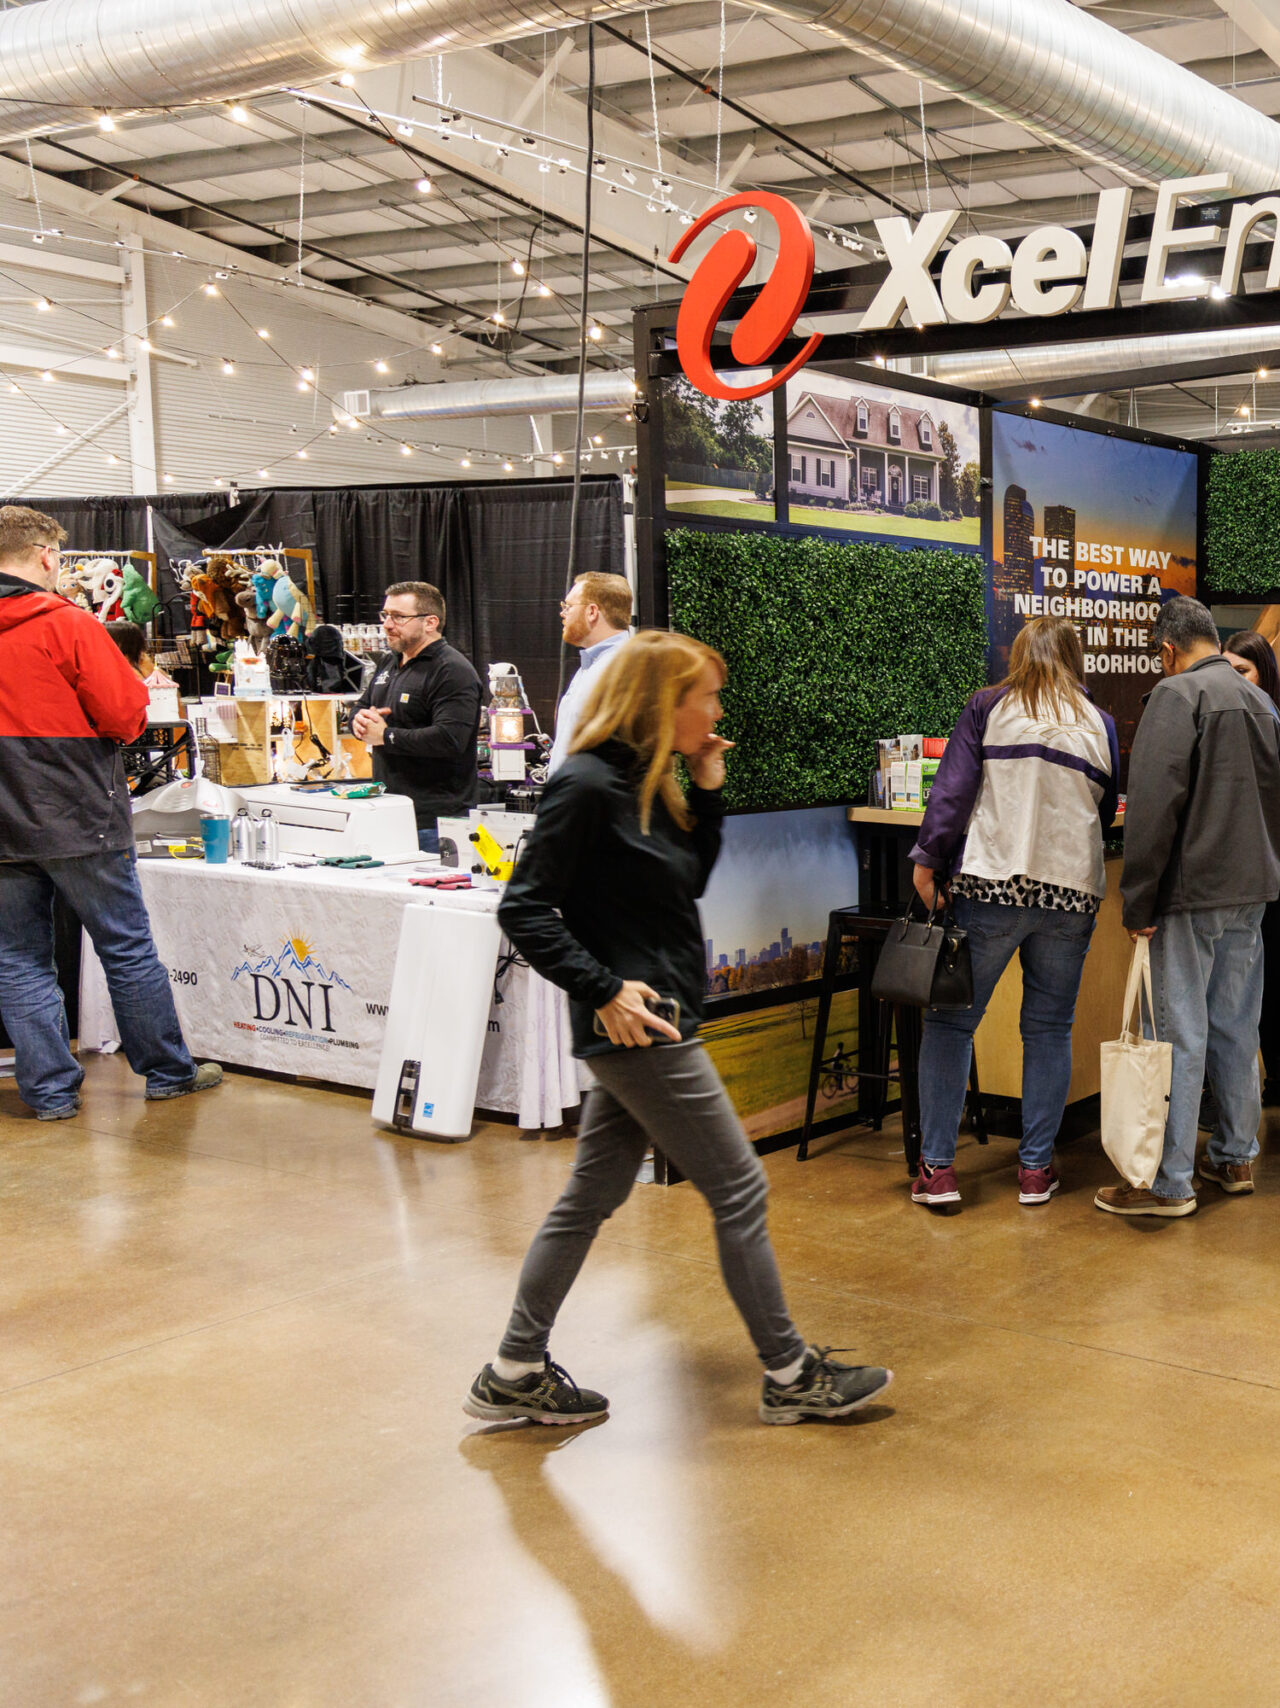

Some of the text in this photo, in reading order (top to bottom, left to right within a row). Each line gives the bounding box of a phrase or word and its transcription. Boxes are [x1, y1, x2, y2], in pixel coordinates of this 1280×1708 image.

[858, 186, 1133, 331] Xcel
[1029, 536, 1172, 570] THE BEST WAY
[1040, 566, 1162, 595] TO POWER A
[1014, 594, 1161, 622] NEIGHBORHOO
[1087, 627, 1108, 646] IN
[1112, 628, 1149, 647] THE
[250, 973, 336, 1032] DNI
